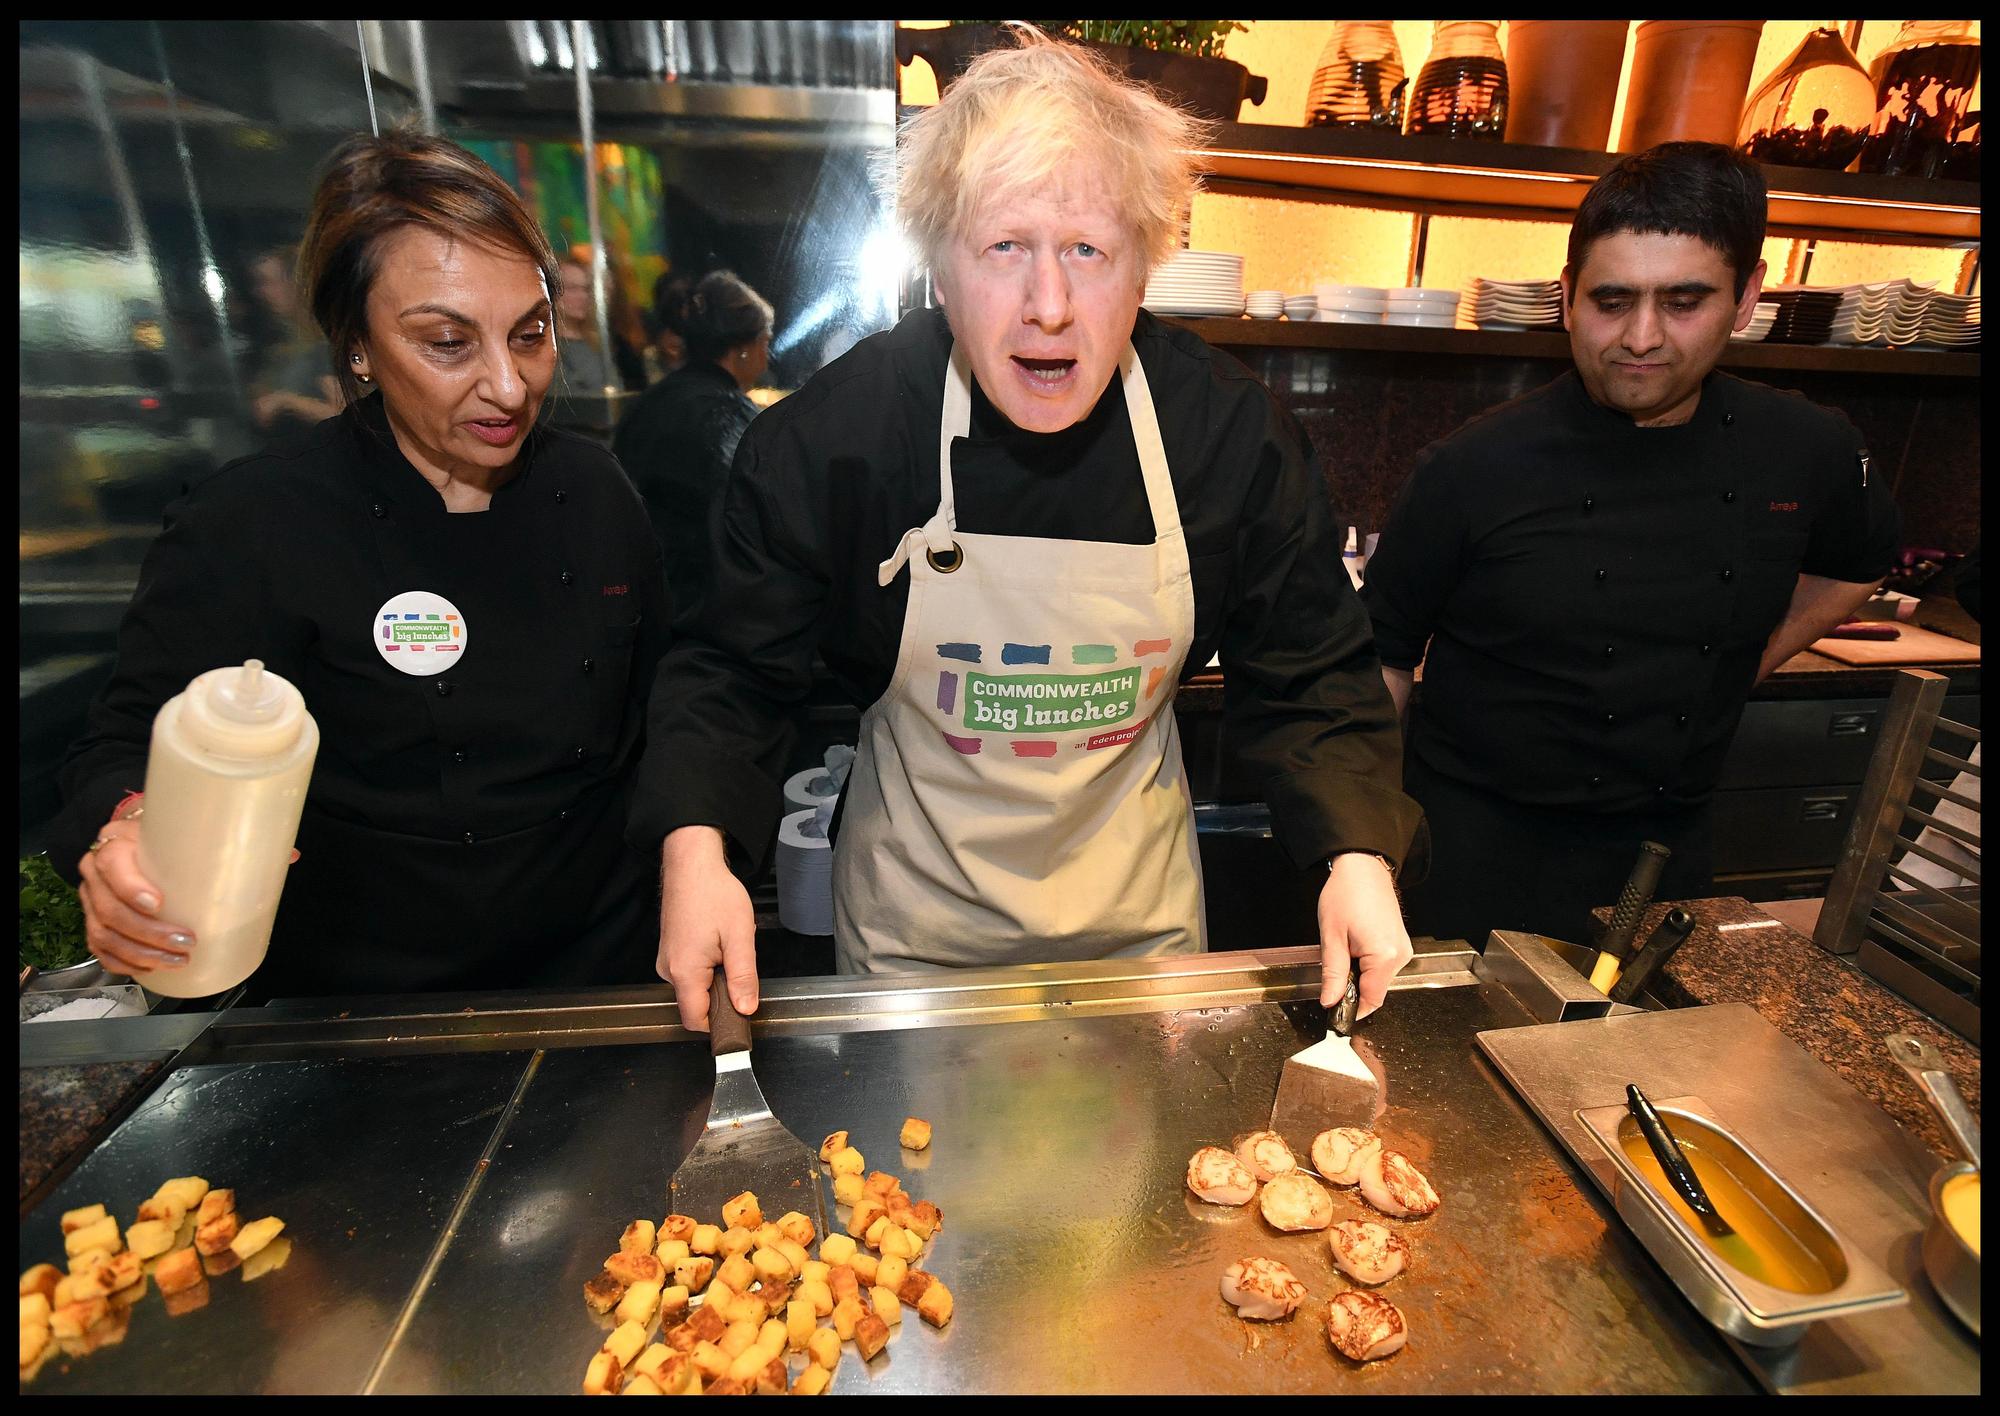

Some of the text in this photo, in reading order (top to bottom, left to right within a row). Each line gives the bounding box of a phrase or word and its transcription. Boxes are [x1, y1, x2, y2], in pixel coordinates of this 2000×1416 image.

[396, 632, 448, 641] big lunches
[972, 675, 1133, 699] COMMONWEALTH
[974, 700, 1130, 731] big lunches
[1092, 735, 1115, 745] eden
